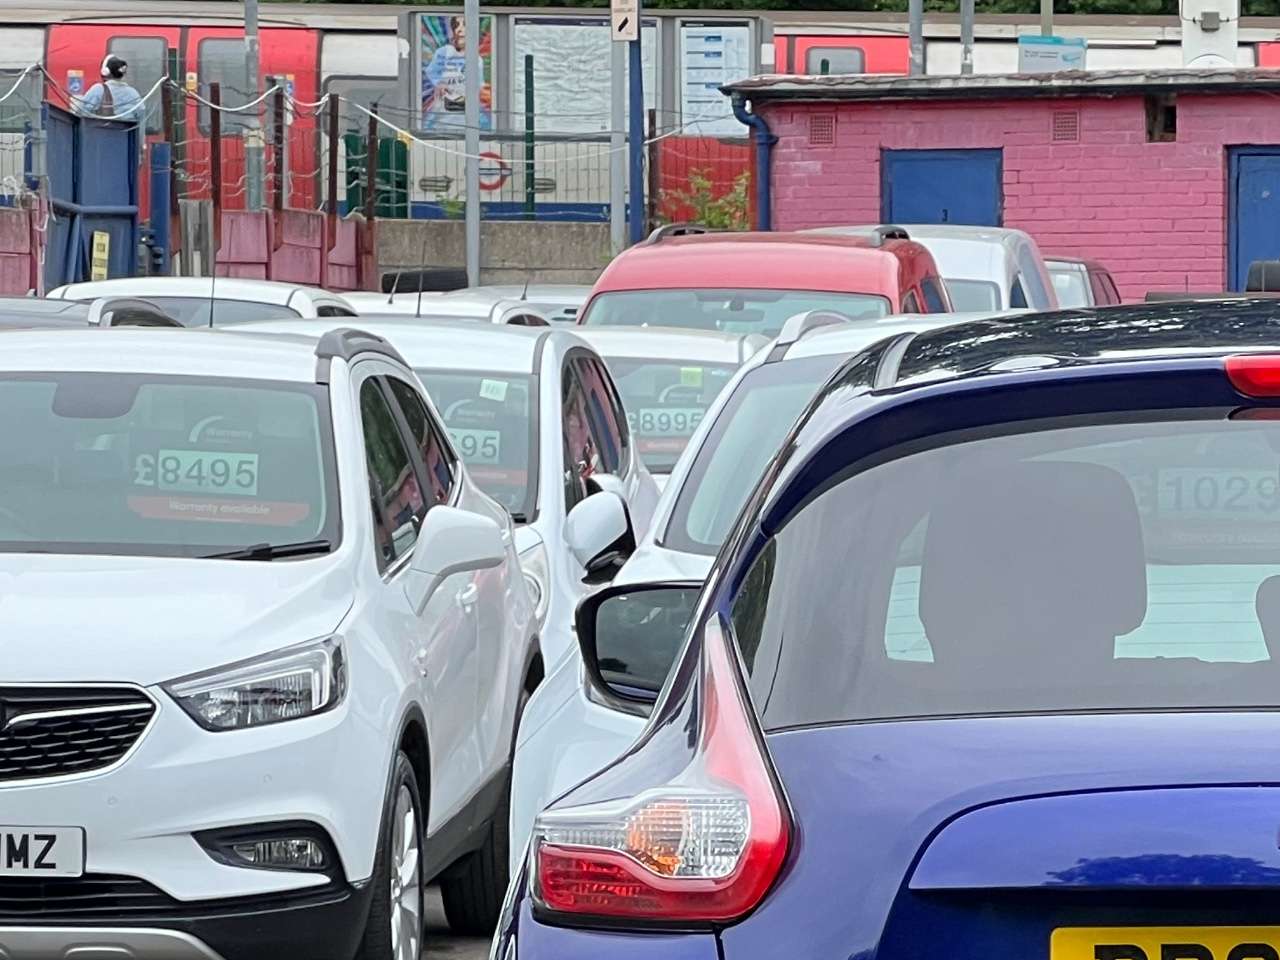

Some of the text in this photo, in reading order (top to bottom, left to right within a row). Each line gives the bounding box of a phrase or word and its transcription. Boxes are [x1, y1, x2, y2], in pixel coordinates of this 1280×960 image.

[942, 208, 949, 222] 3
[450, 432, 498, 459] 95
[133, 453, 256, 489] £8495
[0, 833, 57, 869] MZ
